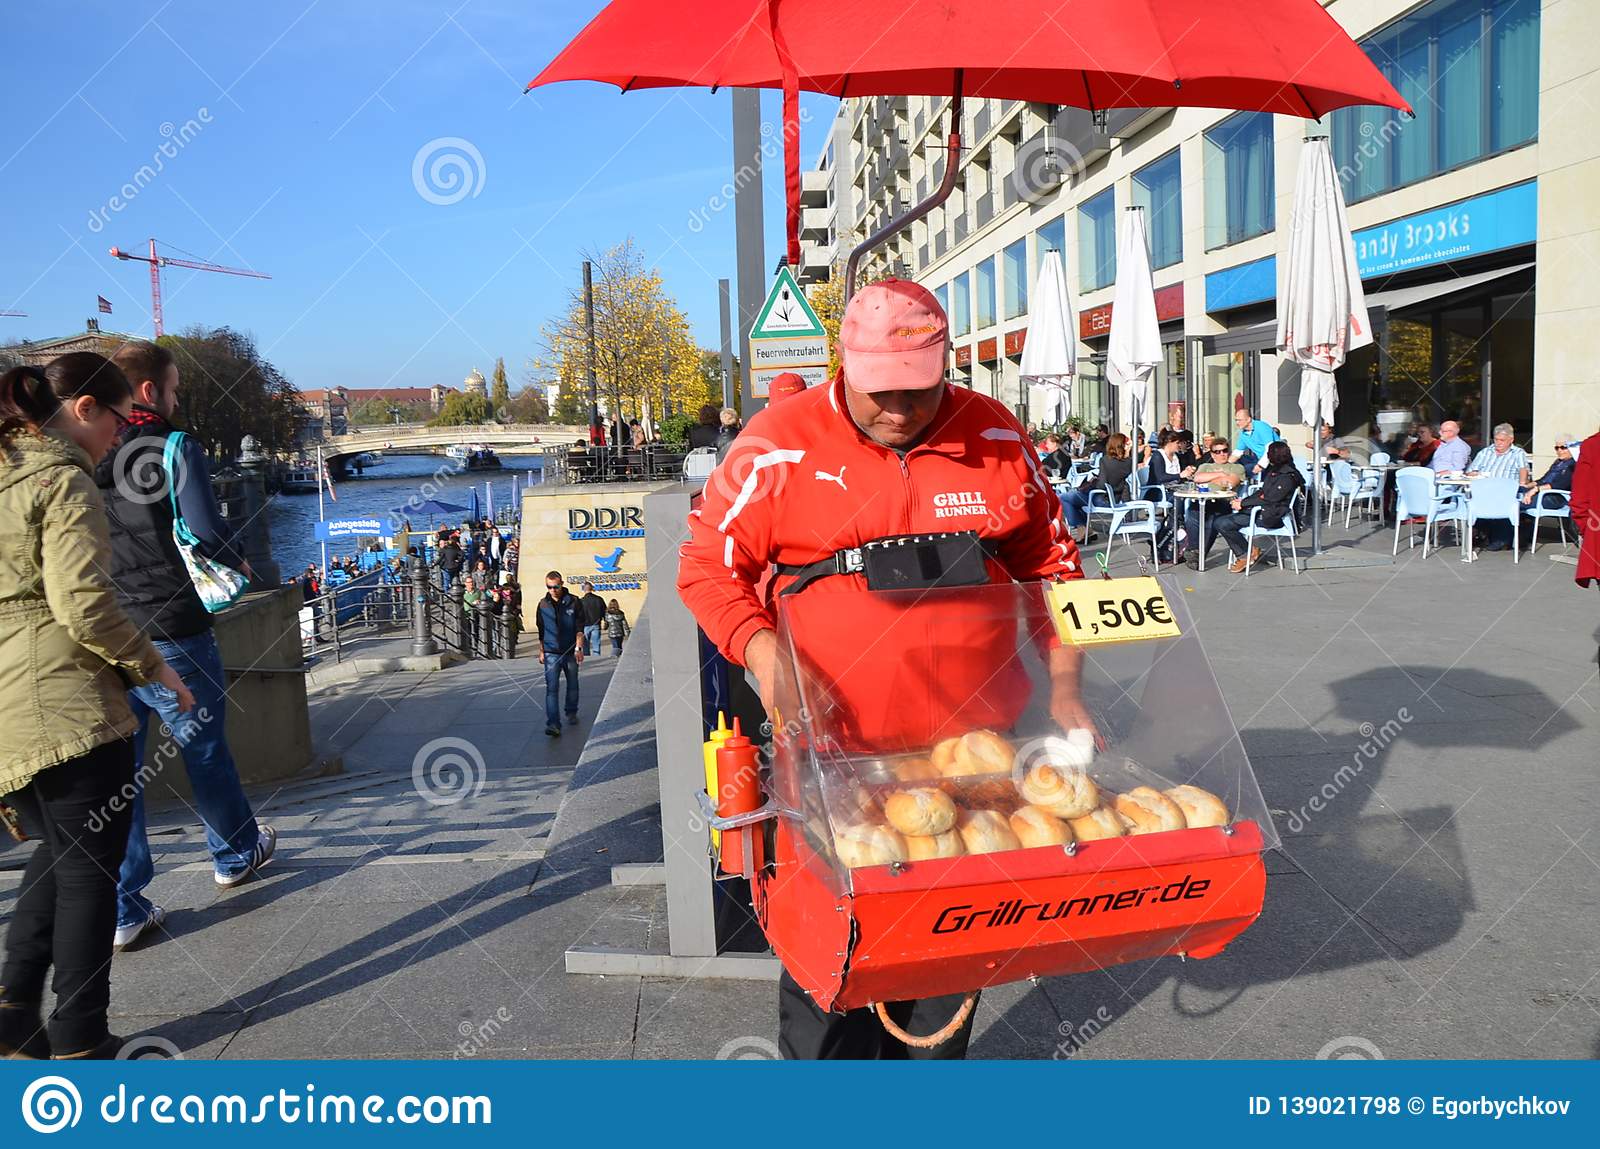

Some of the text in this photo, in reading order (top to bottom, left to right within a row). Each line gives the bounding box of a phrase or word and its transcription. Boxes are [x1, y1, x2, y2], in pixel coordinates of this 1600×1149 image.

[1405, 213, 1470, 249] Brooks
[1376, 262, 1393, 271] cream
[1400, 253, 1432, 266] homemade
[1434, 244, 1470, 258] chocolates
[756, 346, 824, 359] Feuerwehrzufahrt
[934, 491, 986, 507] GRILL
[568, 506, 644, 530] DDR
[935, 505, 988, 518] RUNNER
[328, 519, 381, 530] Anlegestelle
[1061, 596, 1173, 635] 1,50€
[931, 874, 1211, 935] Grillrunner.de
